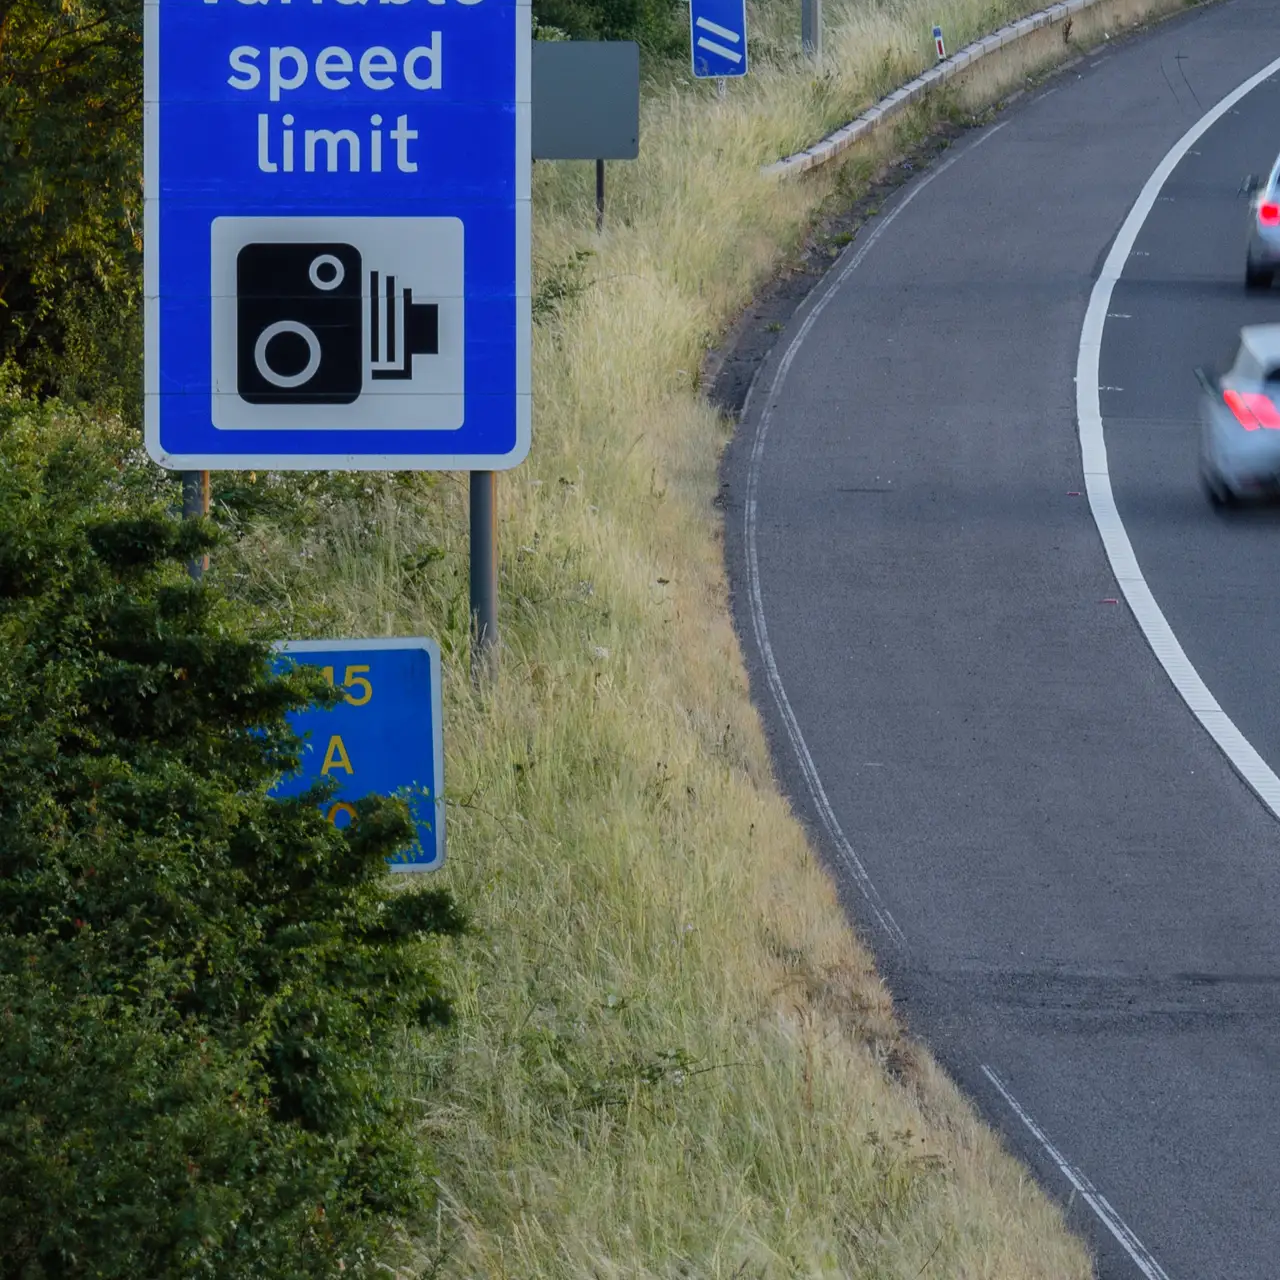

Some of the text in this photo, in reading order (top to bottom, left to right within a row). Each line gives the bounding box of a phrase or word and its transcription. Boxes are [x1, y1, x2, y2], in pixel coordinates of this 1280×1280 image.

[228, 31, 441, 101] speed
[258, 114, 418, 172] limit
[321, 736, 354, 775] A
